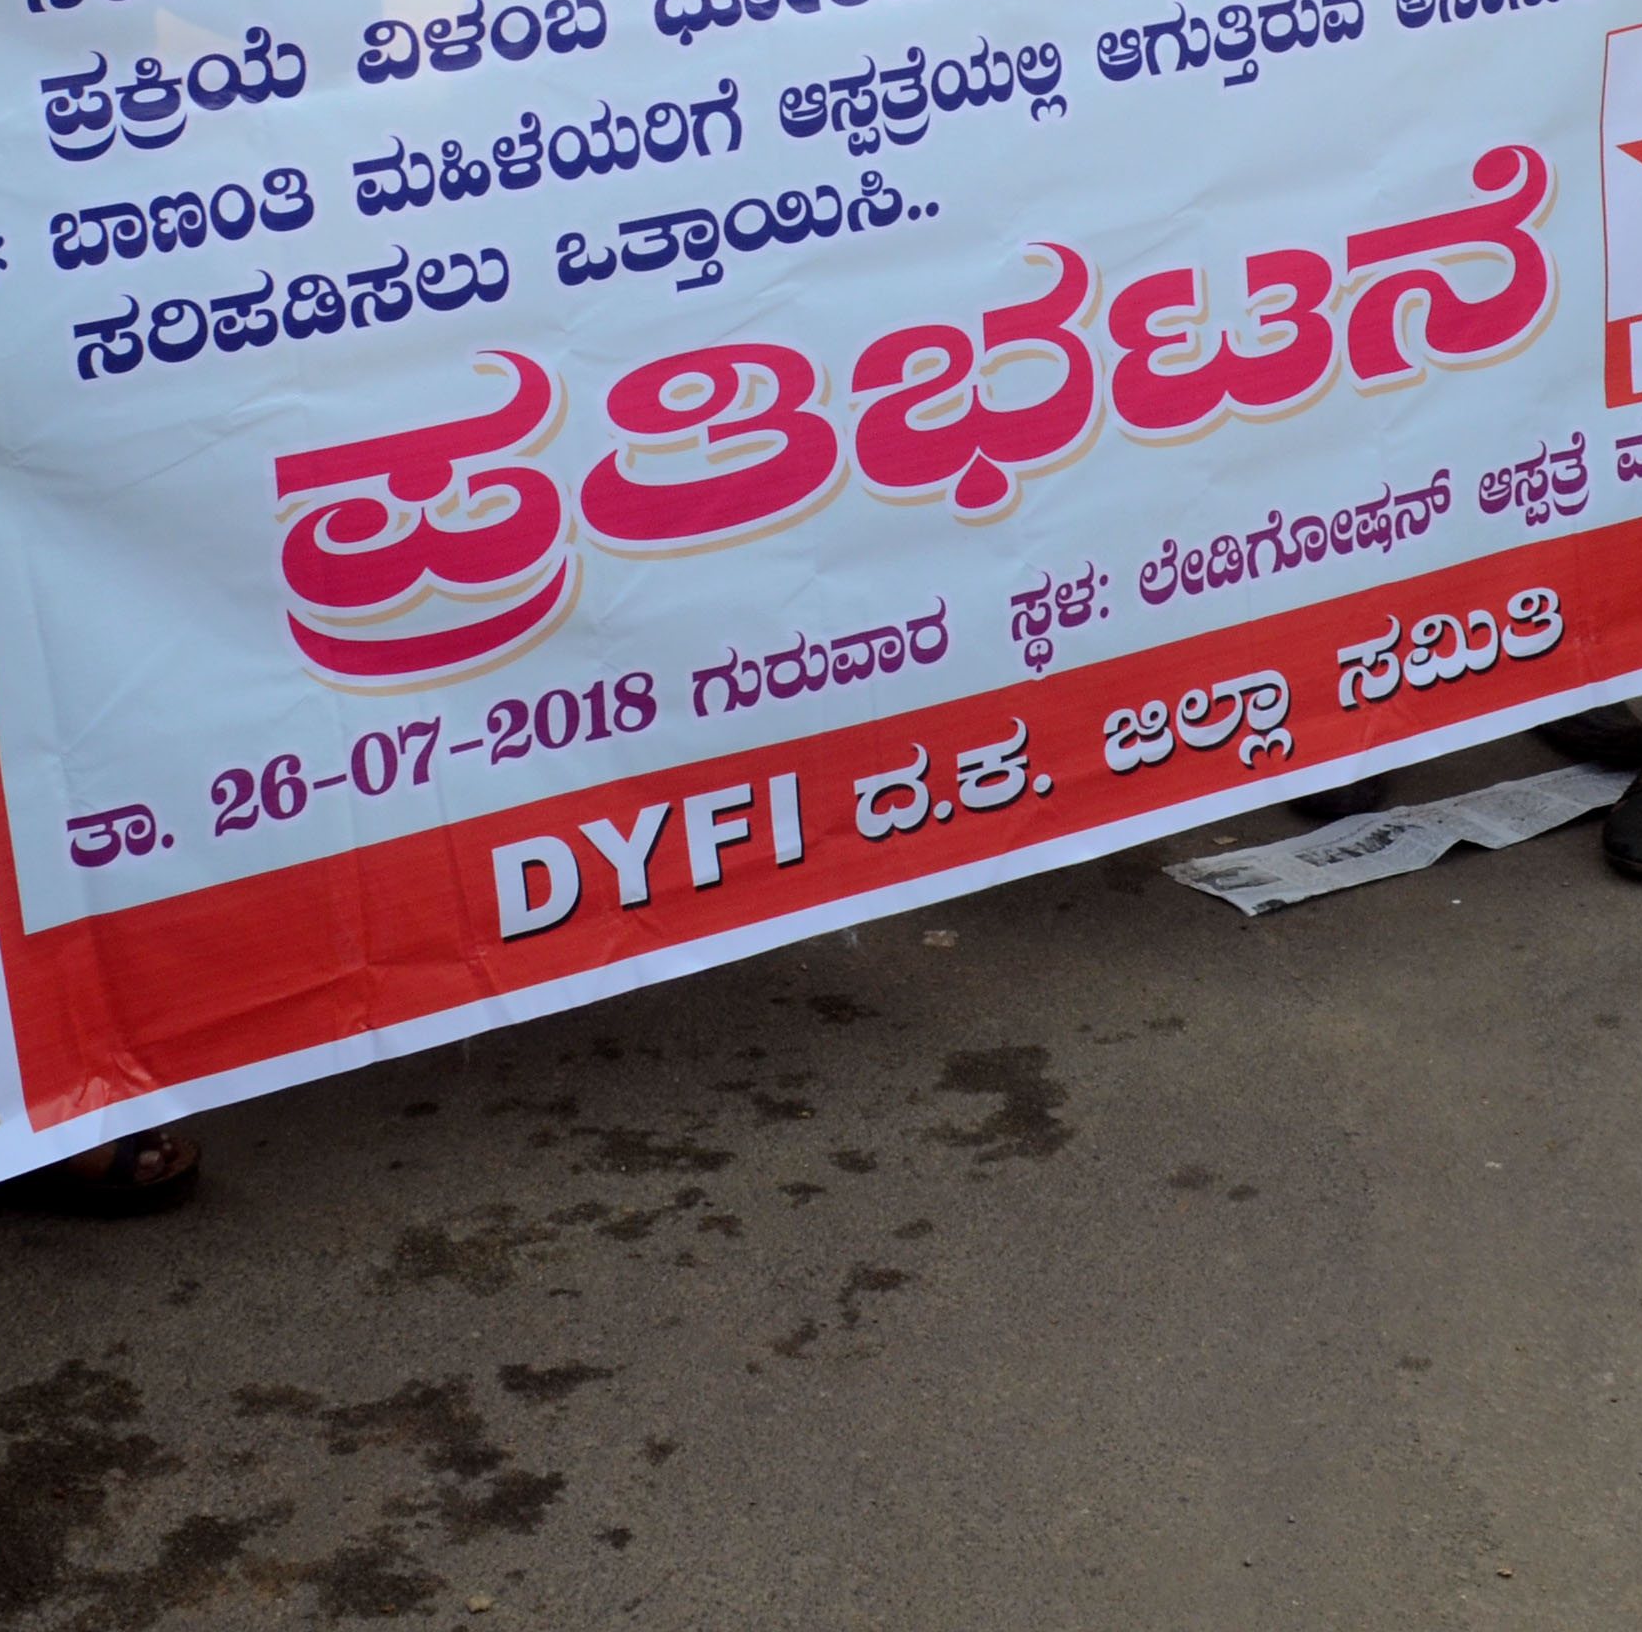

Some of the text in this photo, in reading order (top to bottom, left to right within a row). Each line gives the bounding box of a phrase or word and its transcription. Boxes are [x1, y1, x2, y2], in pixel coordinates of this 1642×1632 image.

[40, 26, 307, 160] ಪ್ರಕ್ರಿಯೆ
[48, 168, 316, 271] ಬಾಣಂತಿ
[352, 77, 744, 218] ಮಹಿಳೆಯರಿಗೆ
[777, 28, 1066, 156] ಆಸ್ಪತ್ರೆಯಲ್ಲಿ
[73, 175, 940, 381] ಸರಿಪಡಿಸಲು ಒತ್ತಾಯಿಸಿ..
[274, 142, 1552, 680] ಪ್ರತಿಭಟನೆ
[65, 801, 174, 869] ತಾ.
[209, 671, 659, 837] 26-07-2018
[690, 596, 949, 718] ಗುರುವಾರ
[1009, 560, 1110, 673] ಸ್ಥಳ:
[1138, 469, 1452, 606] ಲೇಡಿಗೋಷನ್
[1477, 433, 1592, 528] ಆಸ್ಪತ್ರೆ
[490, 586, 1564, 942] DYFI ದ.ಕ. ಜಿಲ್ಲಾ ಸಮಿತಿ
